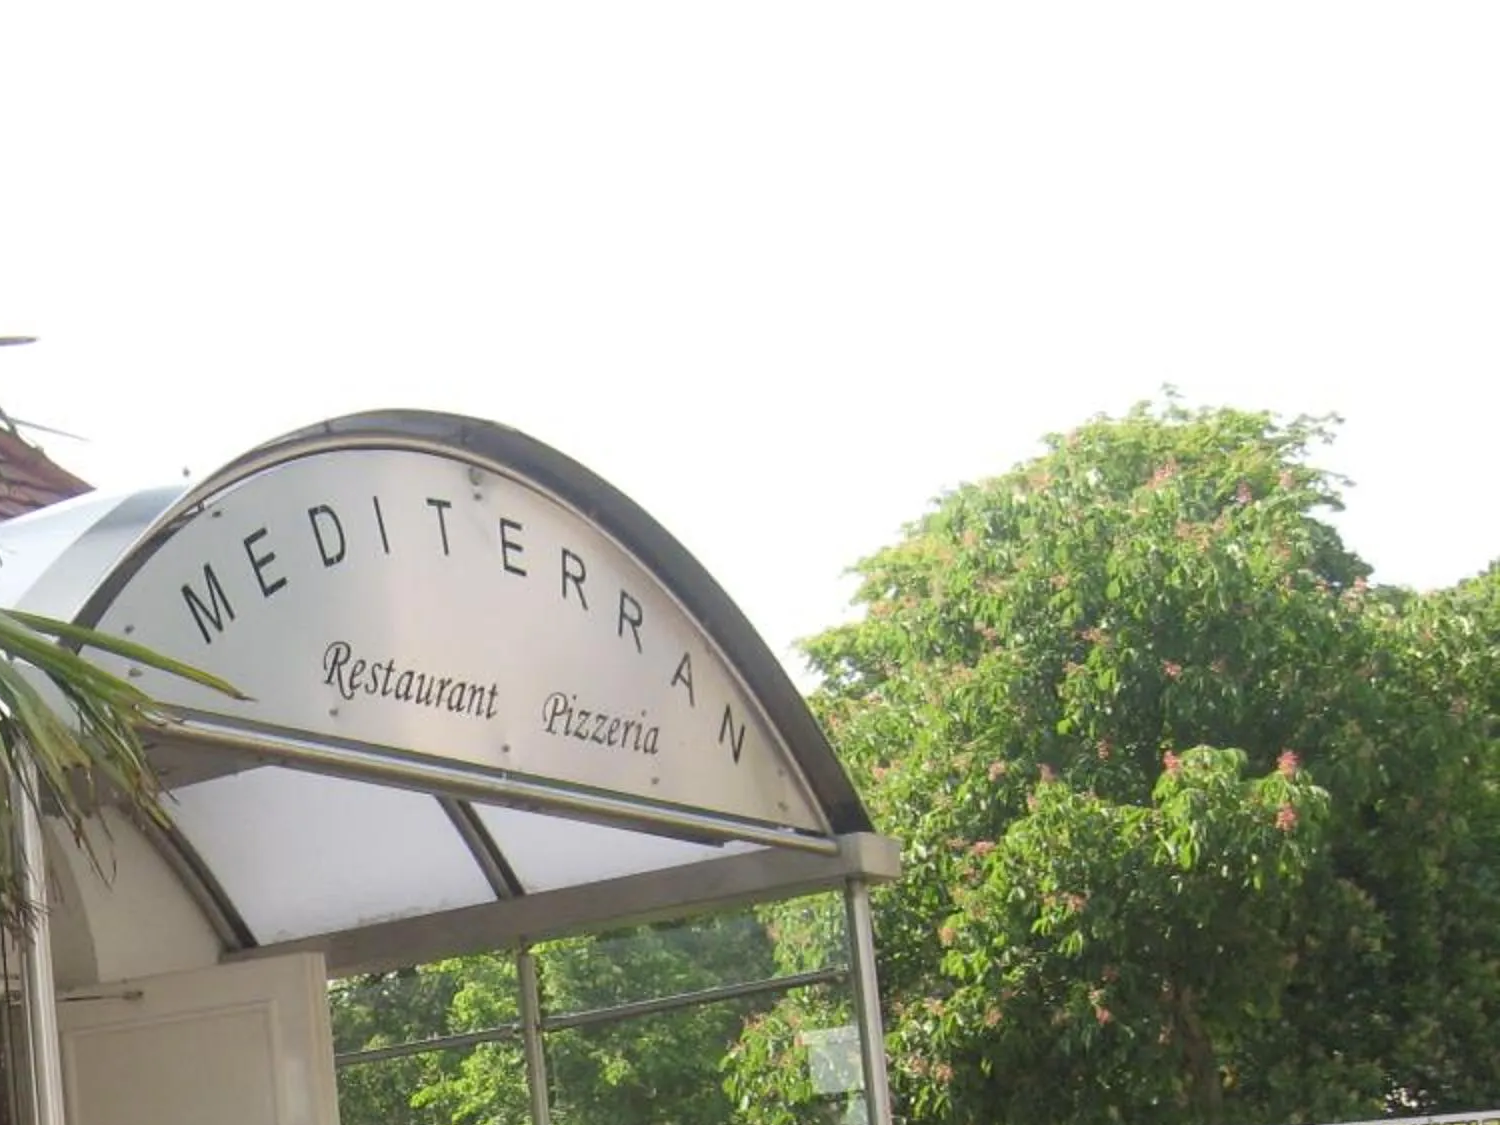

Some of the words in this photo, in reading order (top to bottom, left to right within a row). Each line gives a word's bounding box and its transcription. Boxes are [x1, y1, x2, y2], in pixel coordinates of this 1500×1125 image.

[181, 495, 746, 765] MEDITERRAN
[323, 641, 498, 720] Restaurant
[543, 691, 660, 755] Pizzeria
